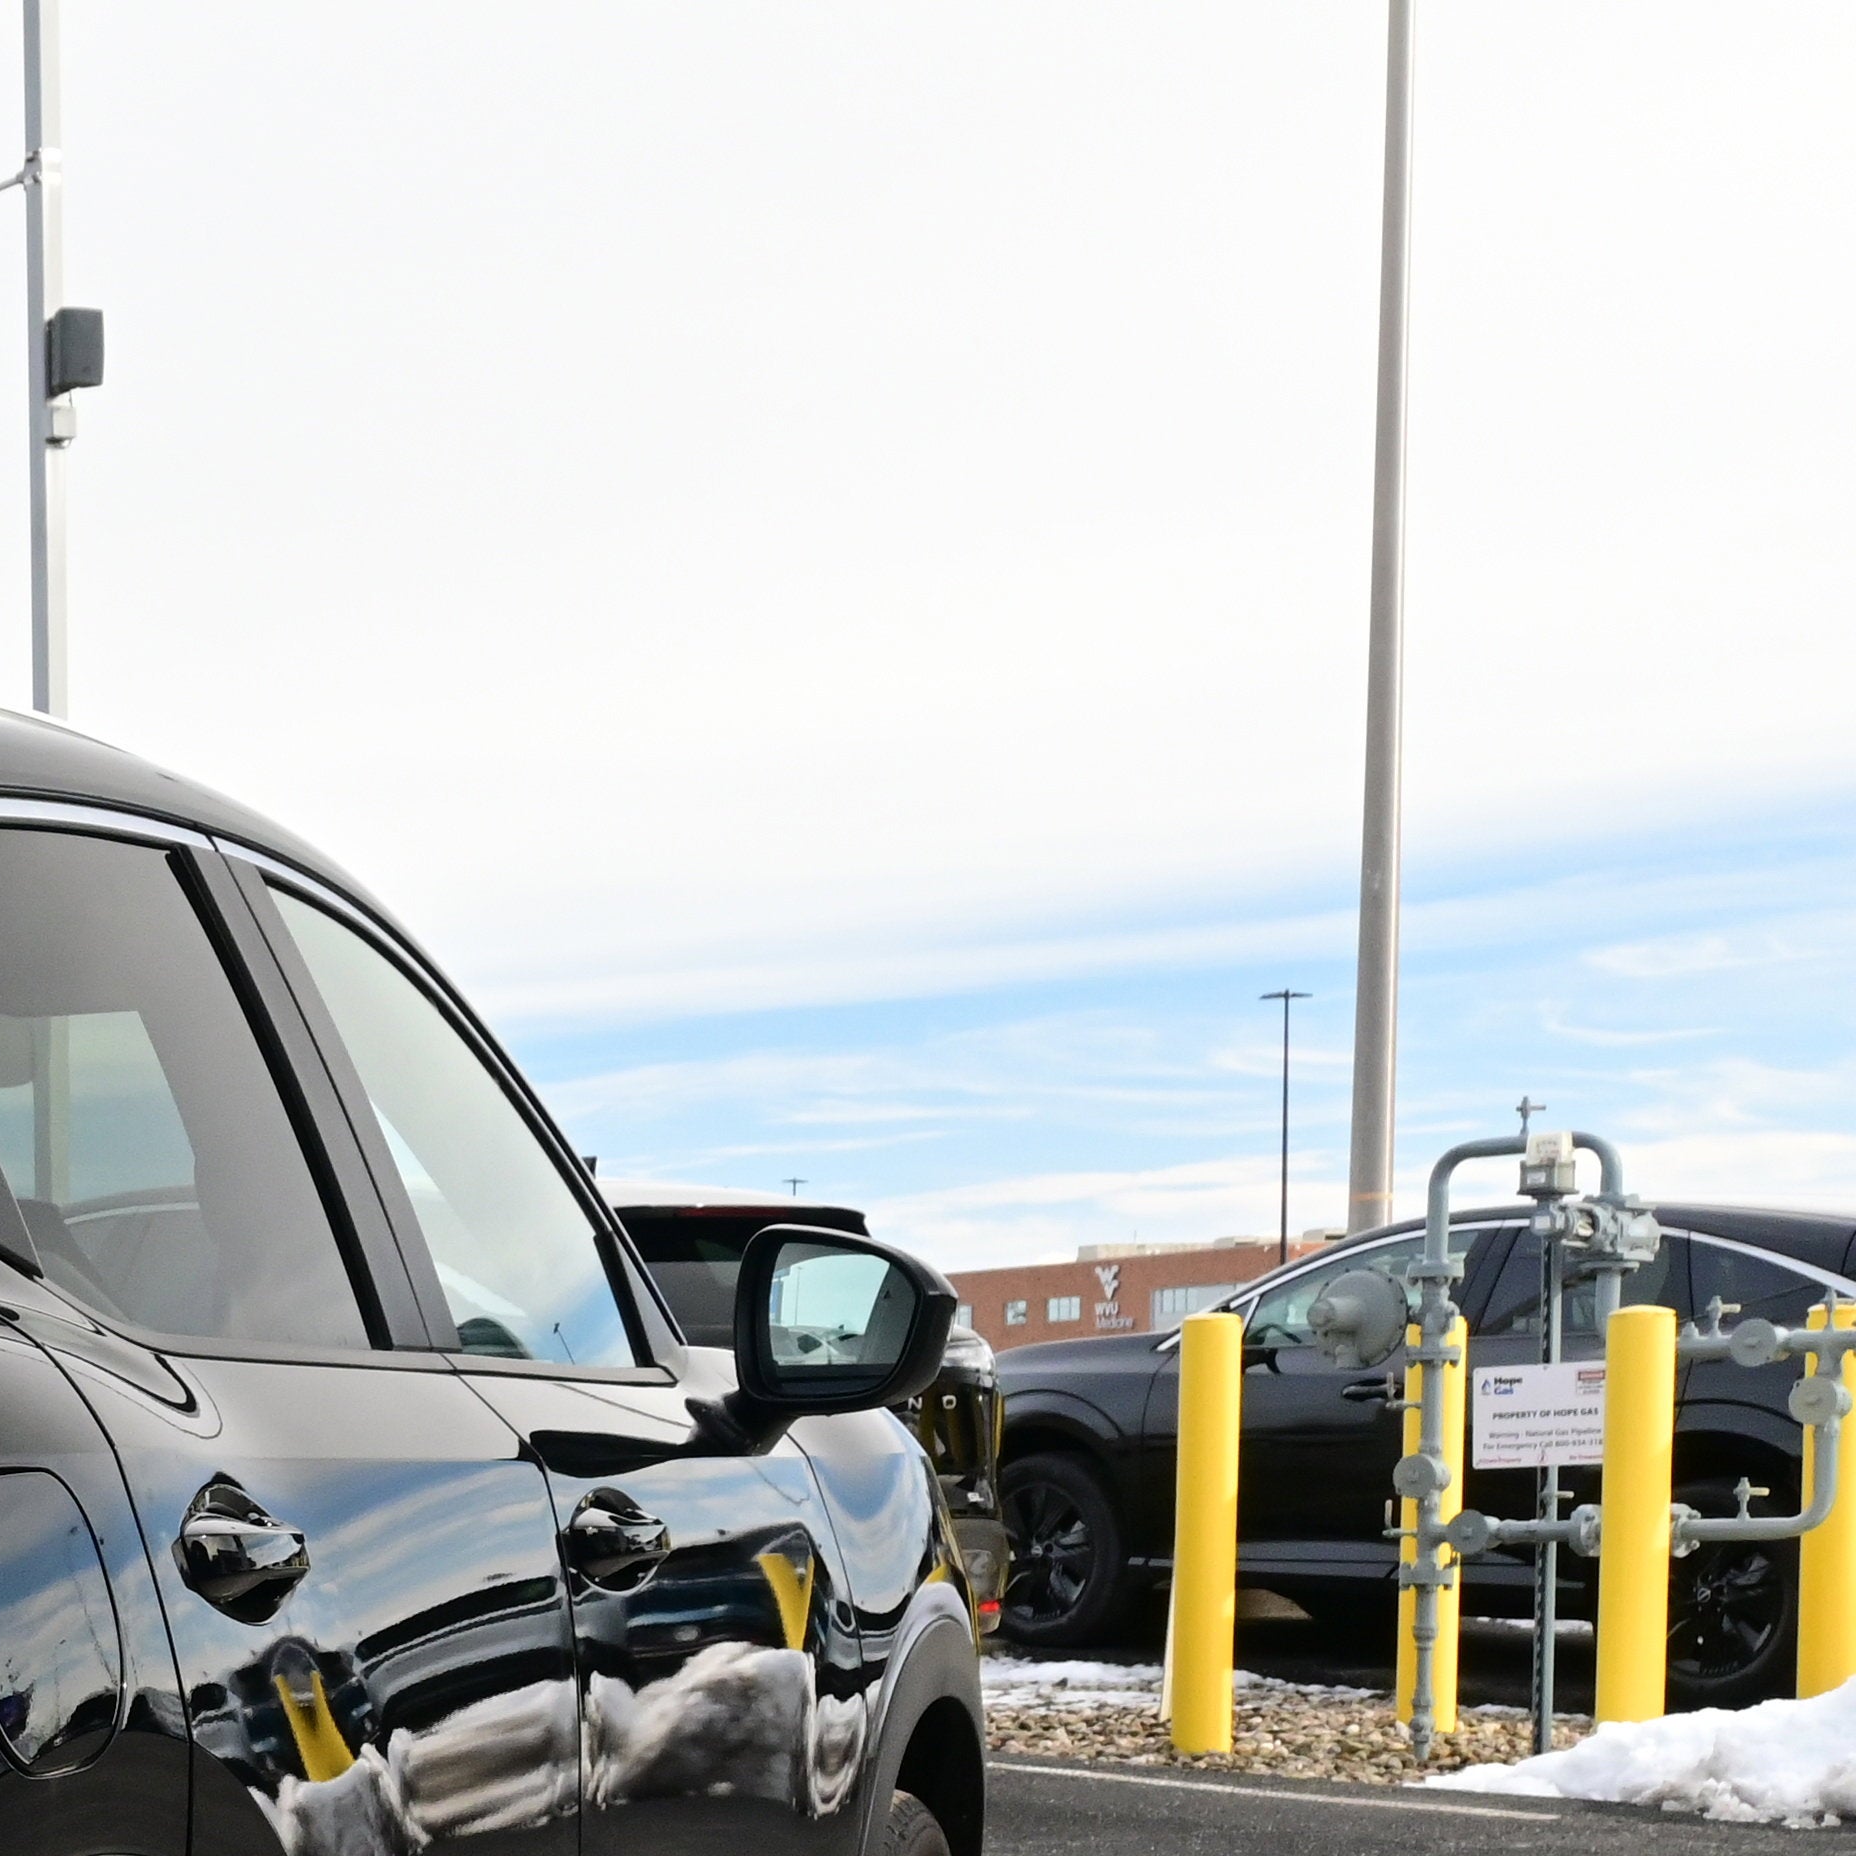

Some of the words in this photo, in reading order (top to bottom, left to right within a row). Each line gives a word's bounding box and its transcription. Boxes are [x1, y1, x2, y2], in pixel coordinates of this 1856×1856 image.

[1494, 1376, 1523, 1387] Hope
[1492, 1410, 1537, 1420] PROPERTY
[1539, 1409, 1551, 1418] OF
[1553, 1408, 1578, 1417] HOPE
[1580, 1407, 1599, 1416] GAS
